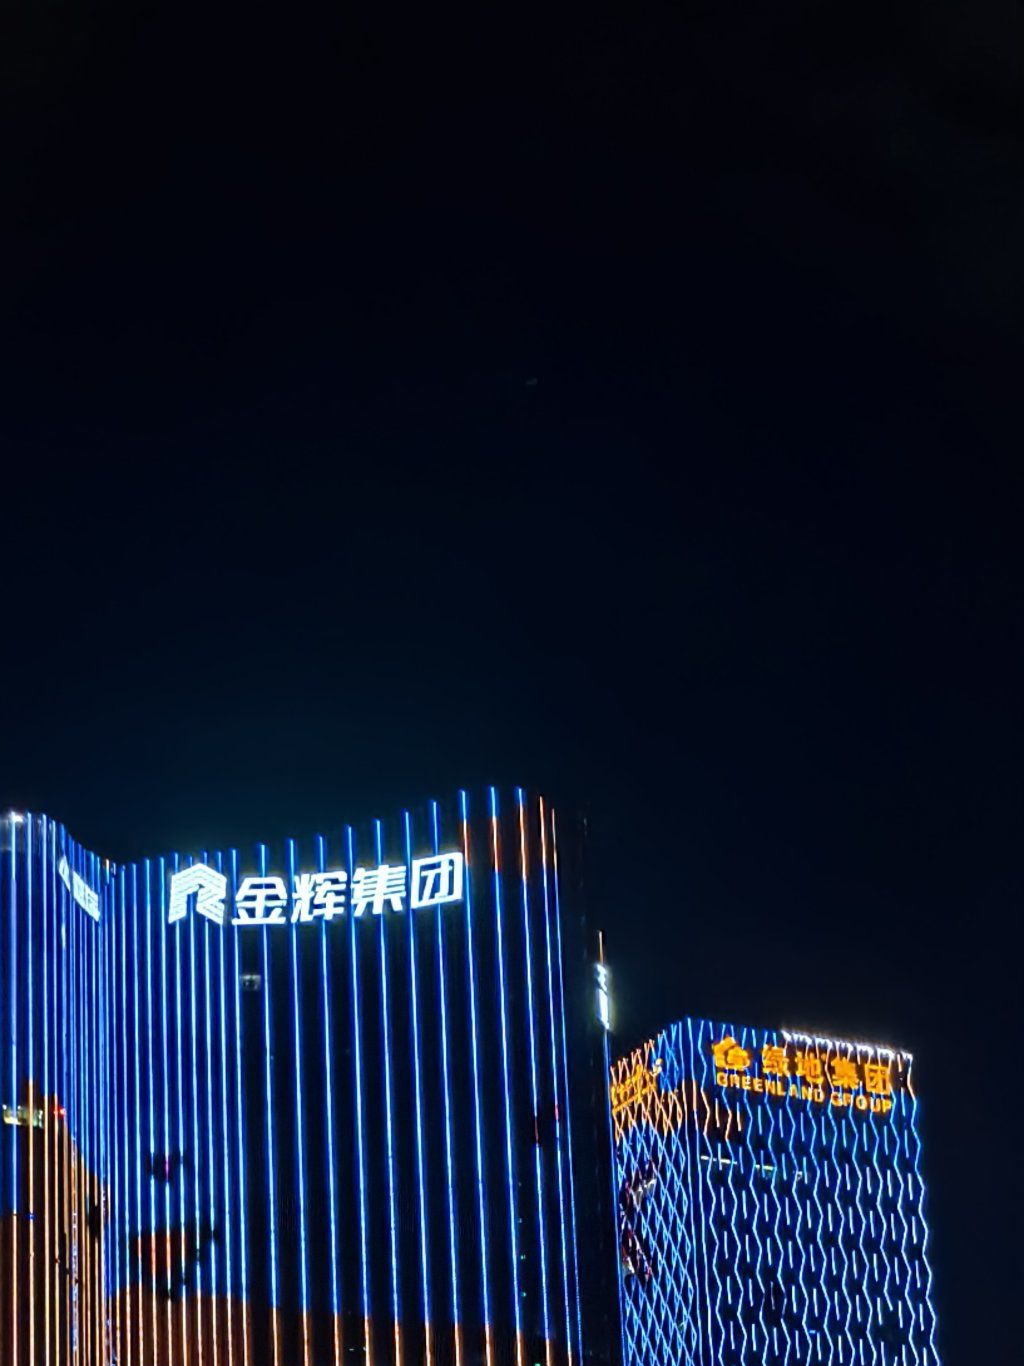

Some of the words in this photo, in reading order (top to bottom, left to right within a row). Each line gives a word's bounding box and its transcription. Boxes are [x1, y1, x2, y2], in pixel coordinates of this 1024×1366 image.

[232, 852, 463, 925] 金辉集团
[716, 1072, 825, 1103] GREENLAND
[830, 1091, 893, 1113] GROUP
[762, 1044, 892, 1095] 绿地集团
